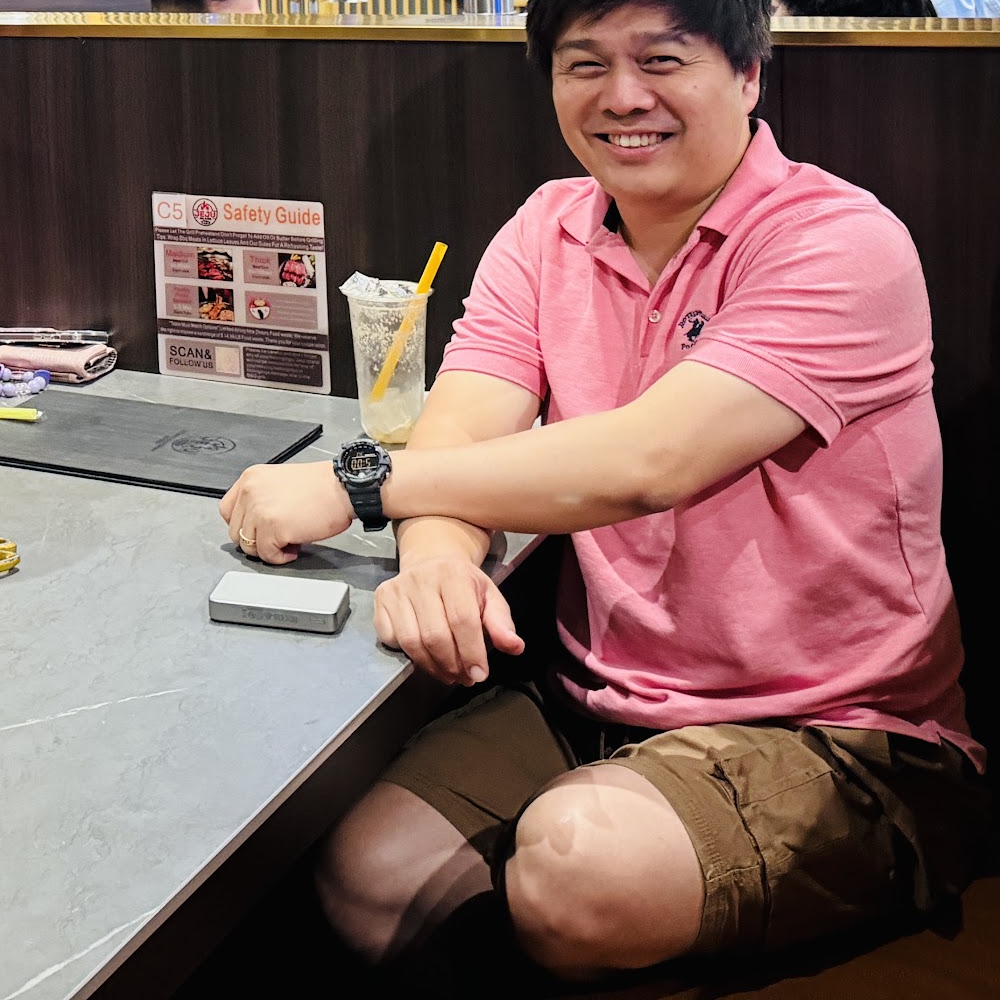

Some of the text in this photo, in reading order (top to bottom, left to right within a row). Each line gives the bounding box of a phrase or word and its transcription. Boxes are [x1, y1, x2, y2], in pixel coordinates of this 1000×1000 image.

[157, 201, 183, 220] C5
[193, 209, 216, 219] JEJU
[223, 203, 321, 226] Safety Guide
[169, 345, 212, 360] SCAN&
[169, 357, 214, 369] FOLLOW US
